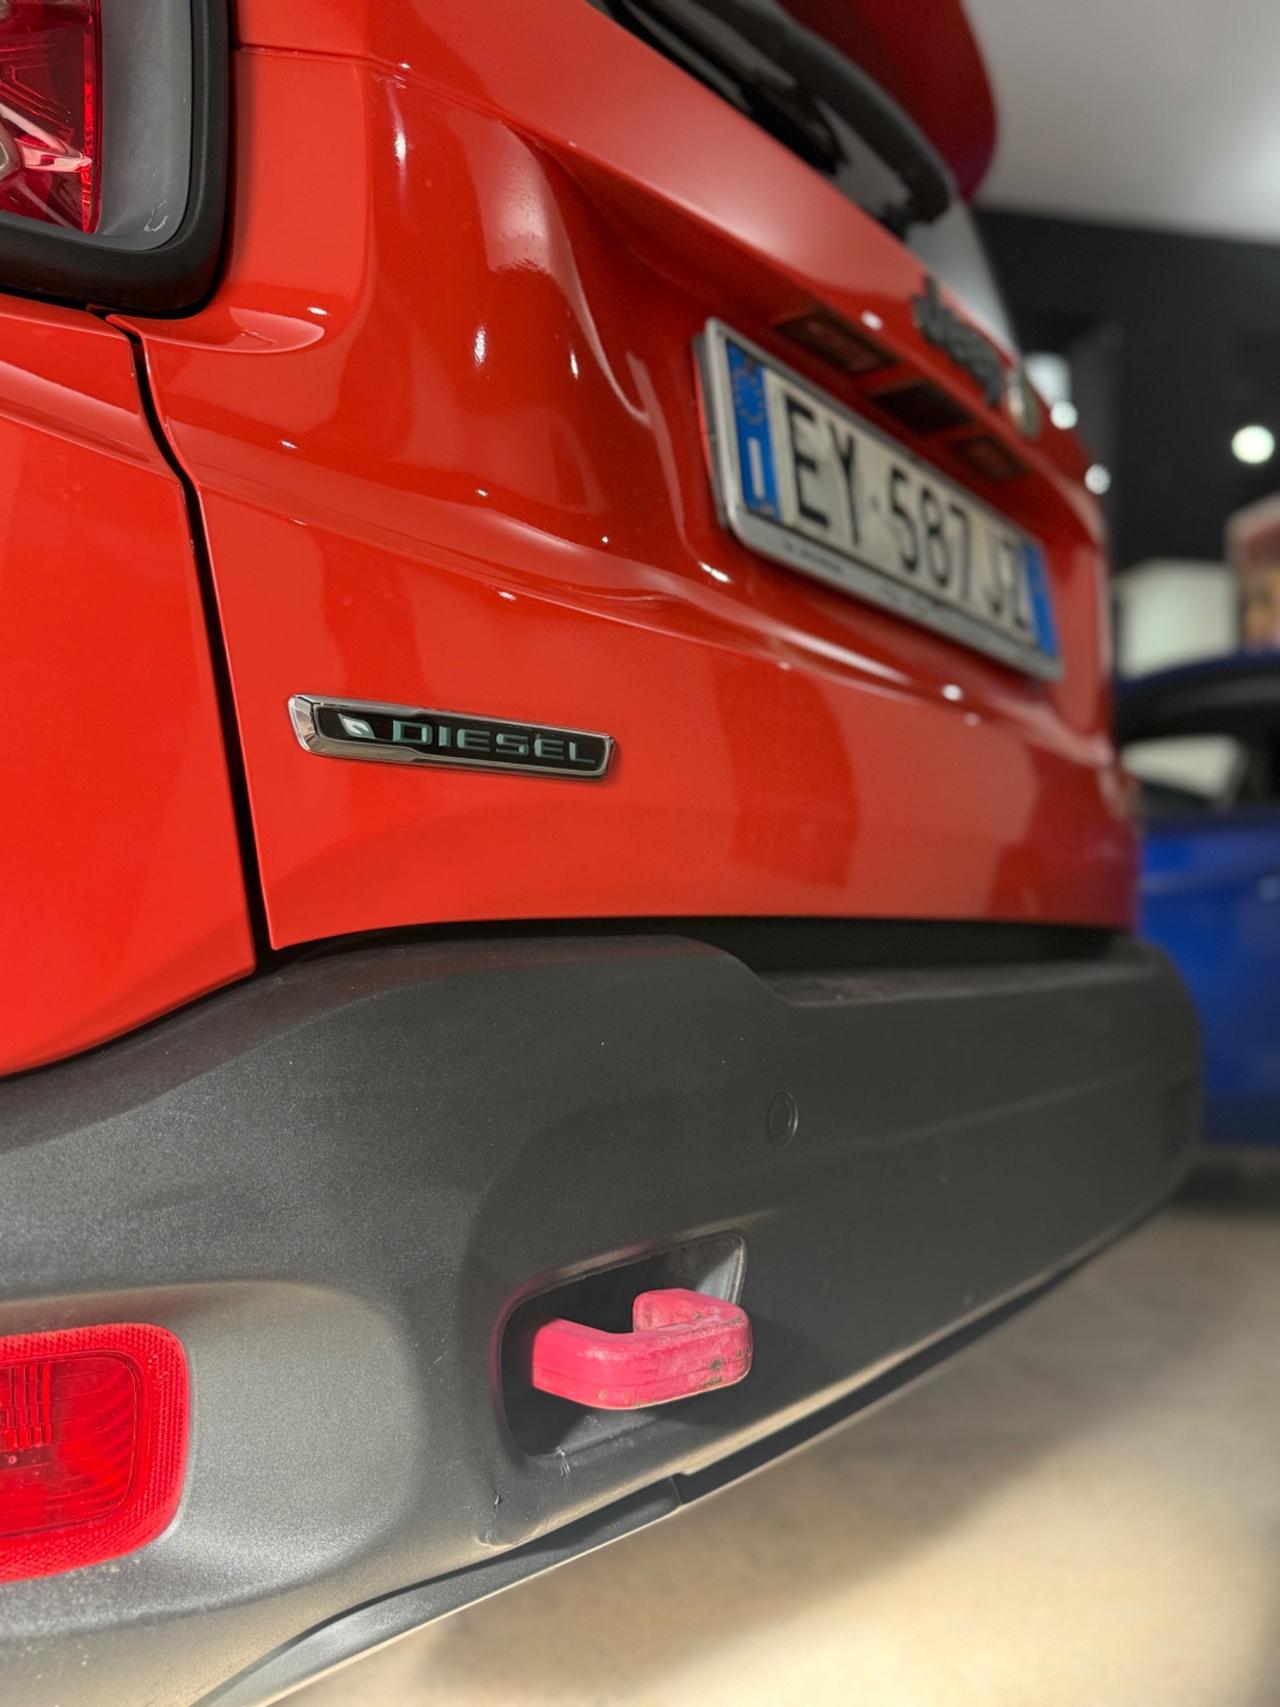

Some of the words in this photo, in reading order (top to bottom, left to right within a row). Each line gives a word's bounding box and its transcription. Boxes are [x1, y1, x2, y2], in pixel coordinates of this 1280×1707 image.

[785, 397, 859, 545] EY
[889, 468, 969, 600] 587
[392, 719, 596, 765] DIESEL
